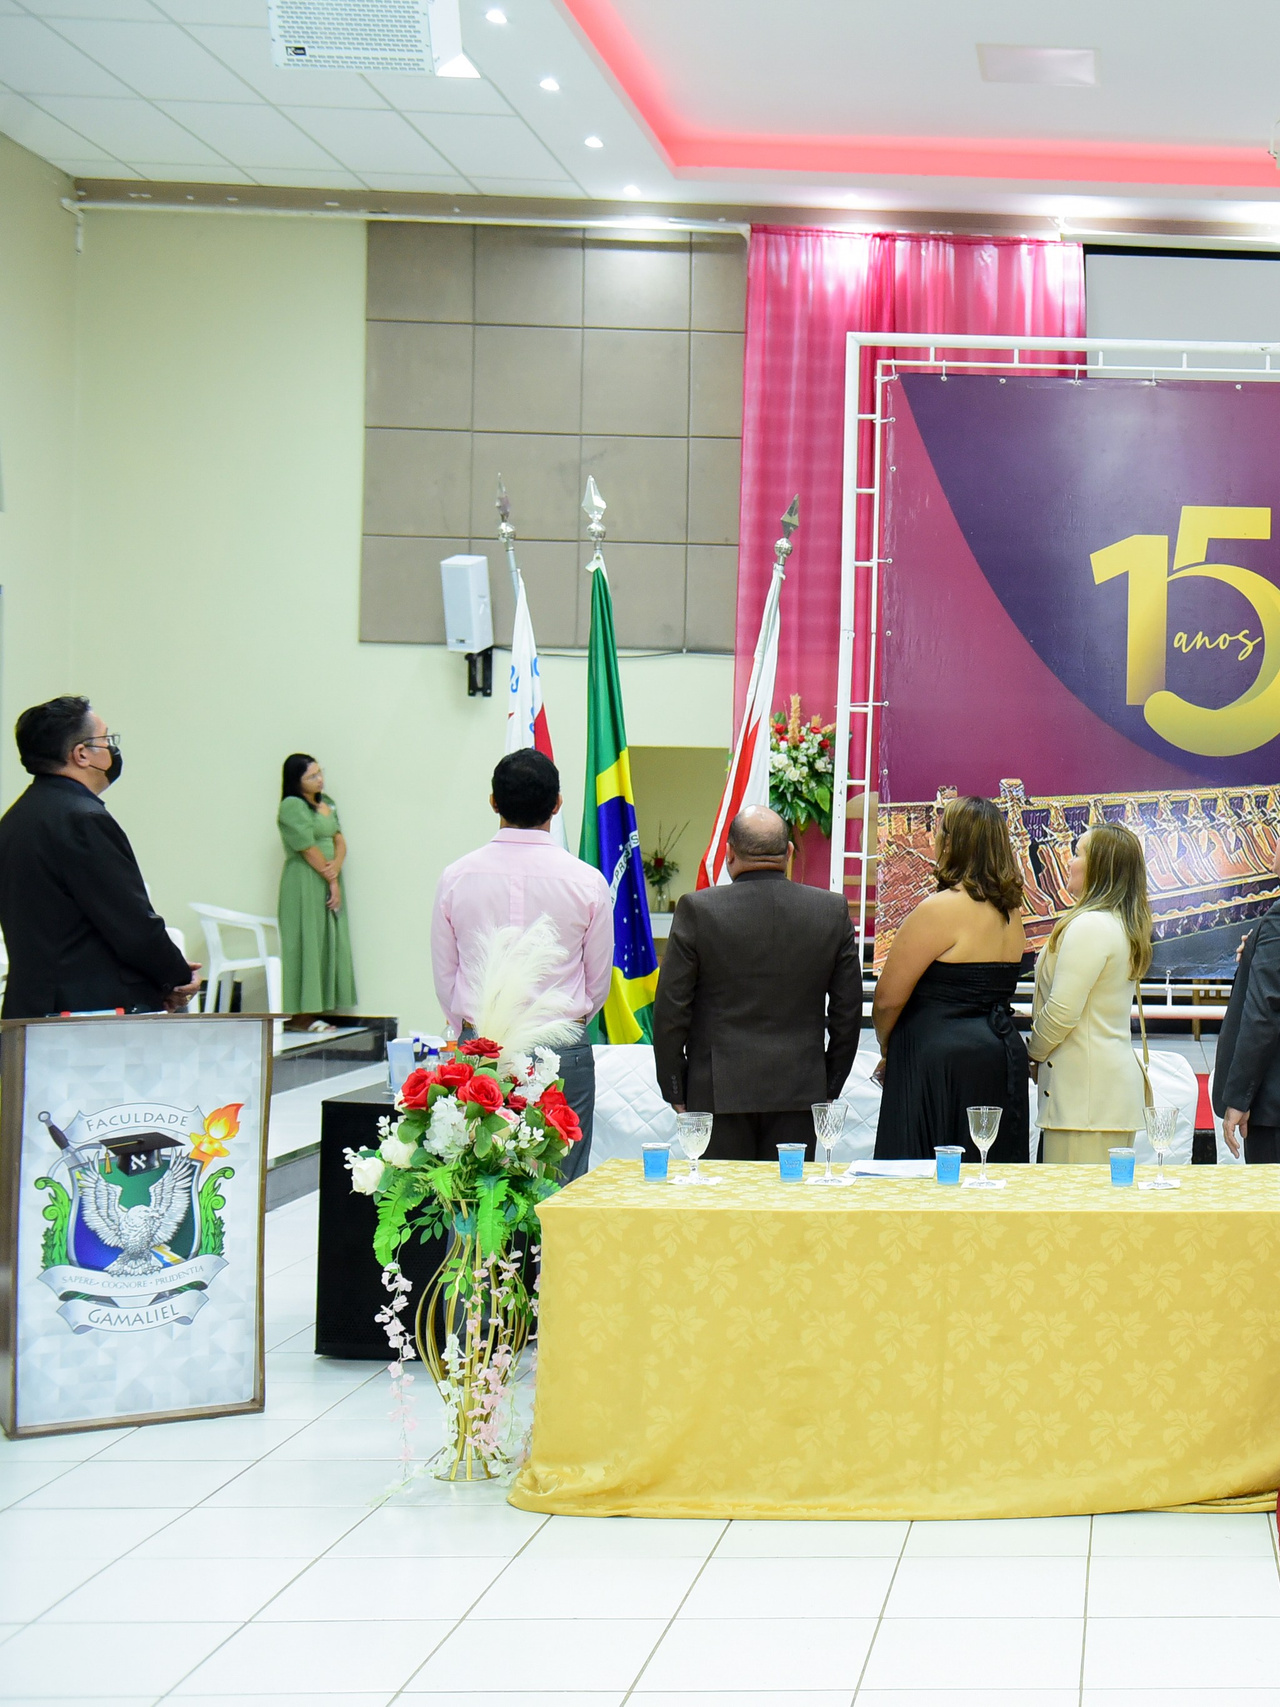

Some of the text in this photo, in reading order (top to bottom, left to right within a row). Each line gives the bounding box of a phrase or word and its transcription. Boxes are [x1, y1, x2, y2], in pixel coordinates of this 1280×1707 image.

[1173, 624, 1263, 661] anos
[86, 1113, 189, 1132] FACULDADE
[62, 1264, 204, 1289] SAPERE COGNORE PRUDENTIA
[88, 1304, 180, 1326] GAMALIEL
